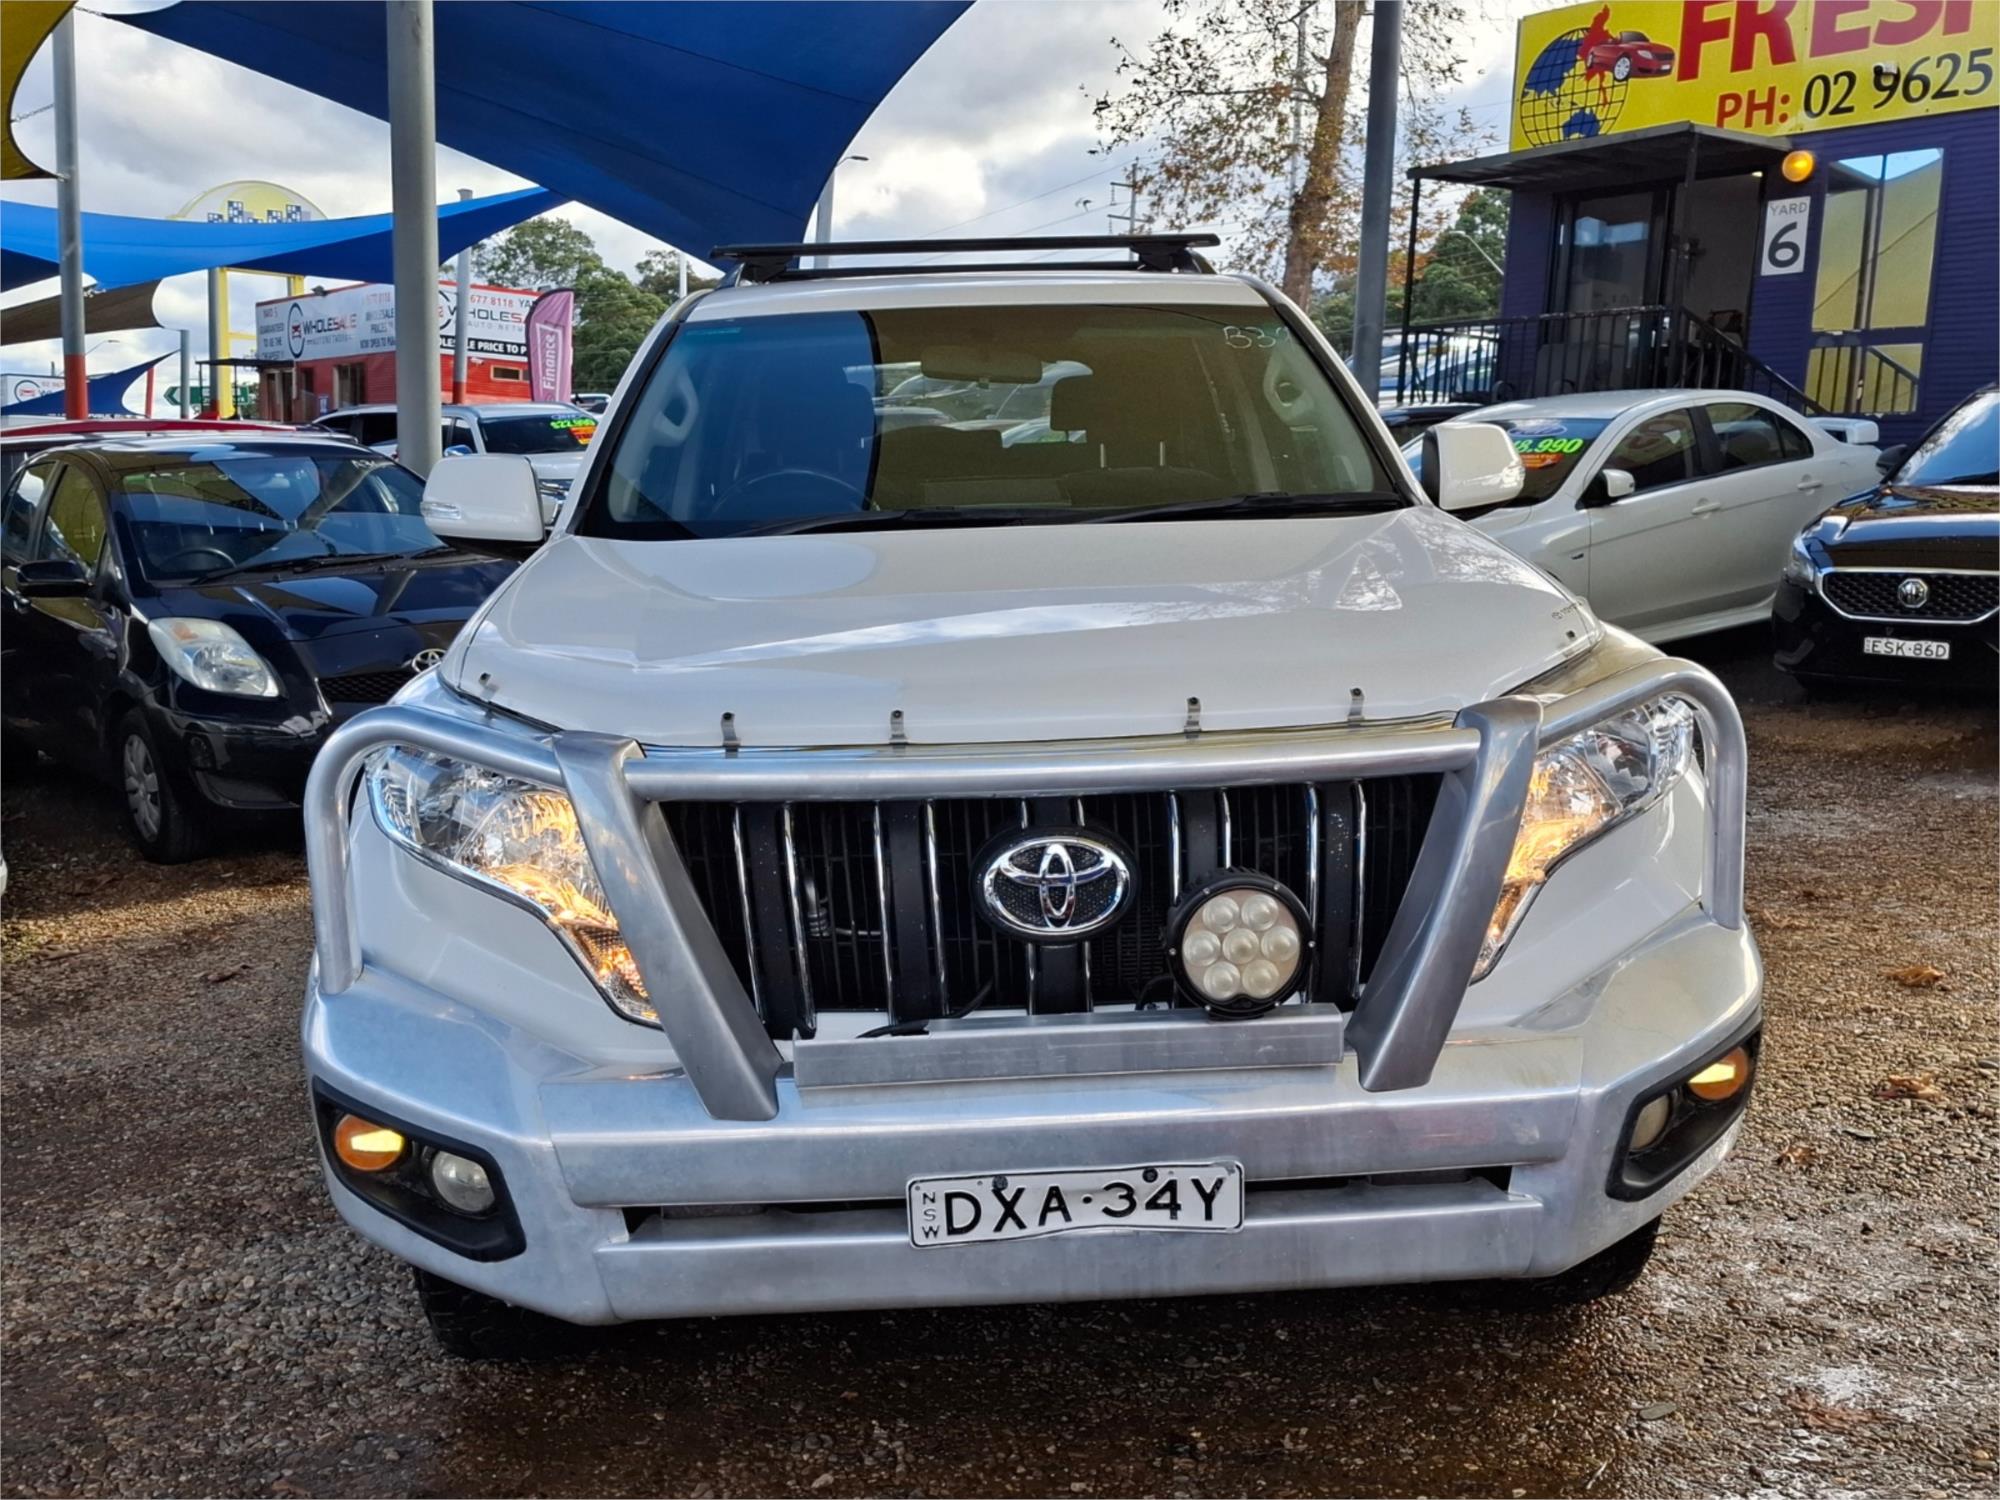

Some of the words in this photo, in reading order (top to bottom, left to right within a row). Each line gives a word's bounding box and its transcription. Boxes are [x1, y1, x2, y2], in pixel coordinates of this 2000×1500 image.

[1716, 86, 1791, 128] PH:
[1803, 70, 1856, 119] 02
[1873, 47, 1993, 109] 9625
[1770, 202, 1807, 216] YARD
[1768, 221, 1800, 268] 6
[490, 296, 514, 308] 8118
[519, 299, 533, 309] YA
[303, 313, 358, 335] WHOLESALE
[499, 322, 523, 332] NETW
[477, 341, 504, 353] PRICE
[506, 343, 518, 354] TO
[542, 334, 556, 391] Finance
[1515, 438, 1584, 454] 8.990
